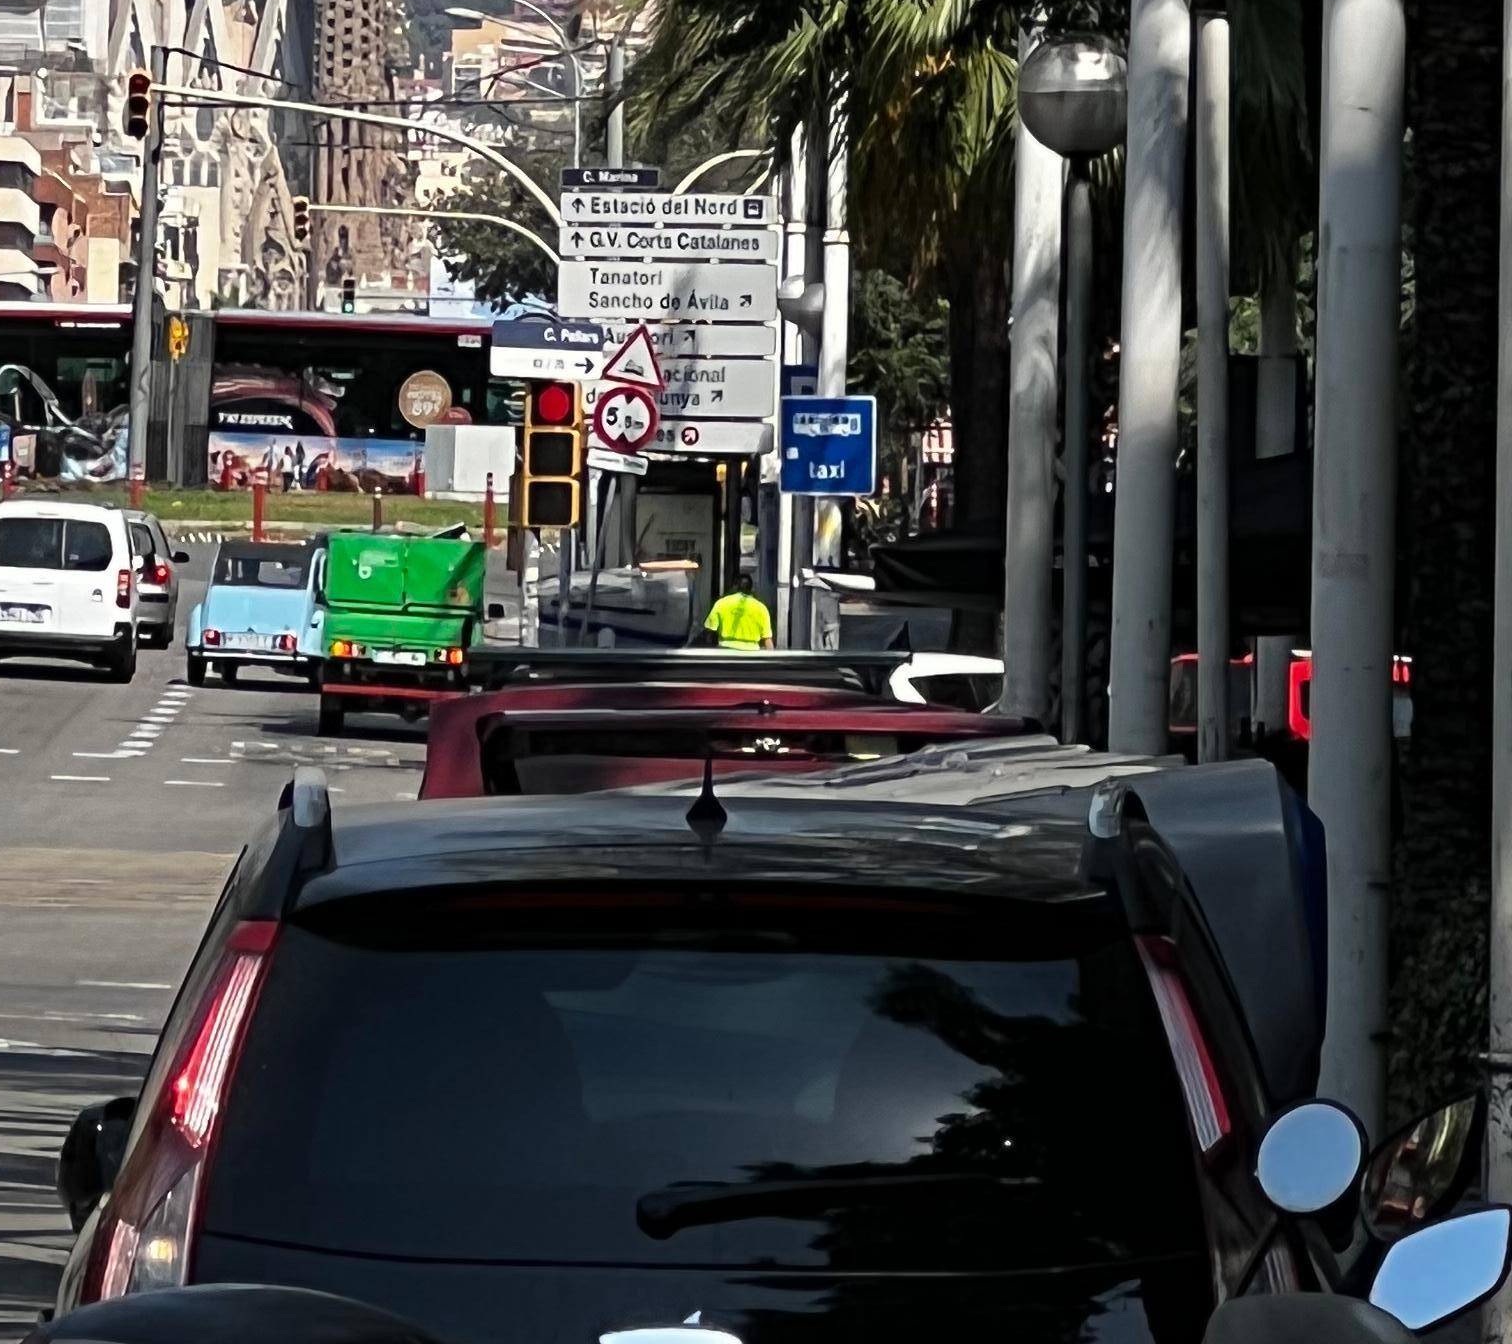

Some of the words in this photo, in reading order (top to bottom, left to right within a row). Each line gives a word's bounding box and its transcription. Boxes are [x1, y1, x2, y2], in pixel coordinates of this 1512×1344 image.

[590, 197, 656, 215] Estació
[662, 198, 688, 215] del
[694, 198, 738, 215] Nord
[677, 232, 760, 251] Catalanes
[589, 267, 663, 286] Tanatori
[588, 291, 653, 310] Sancho
[659, 292, 681, 310] de
[688, 289, 730, 311] Ávila
[809, 459, 845, 480] taxi
